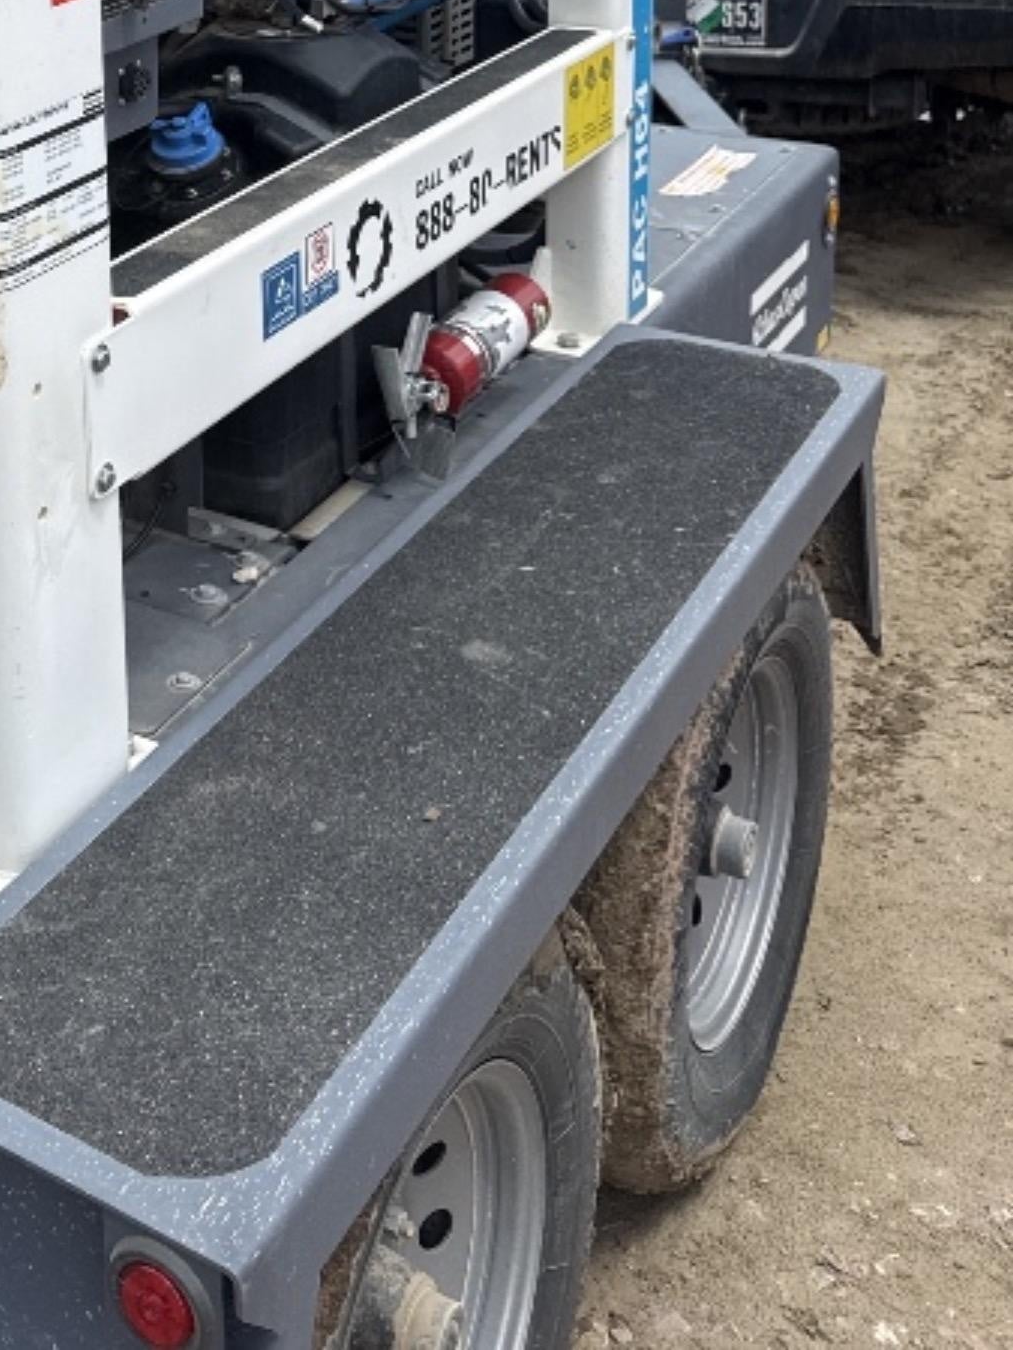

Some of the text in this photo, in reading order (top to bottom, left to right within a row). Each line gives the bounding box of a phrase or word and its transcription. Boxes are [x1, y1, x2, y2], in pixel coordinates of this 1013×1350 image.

[416, 147, 474, 200] CALL NOW
[631, 194, 647, 301] PAC
